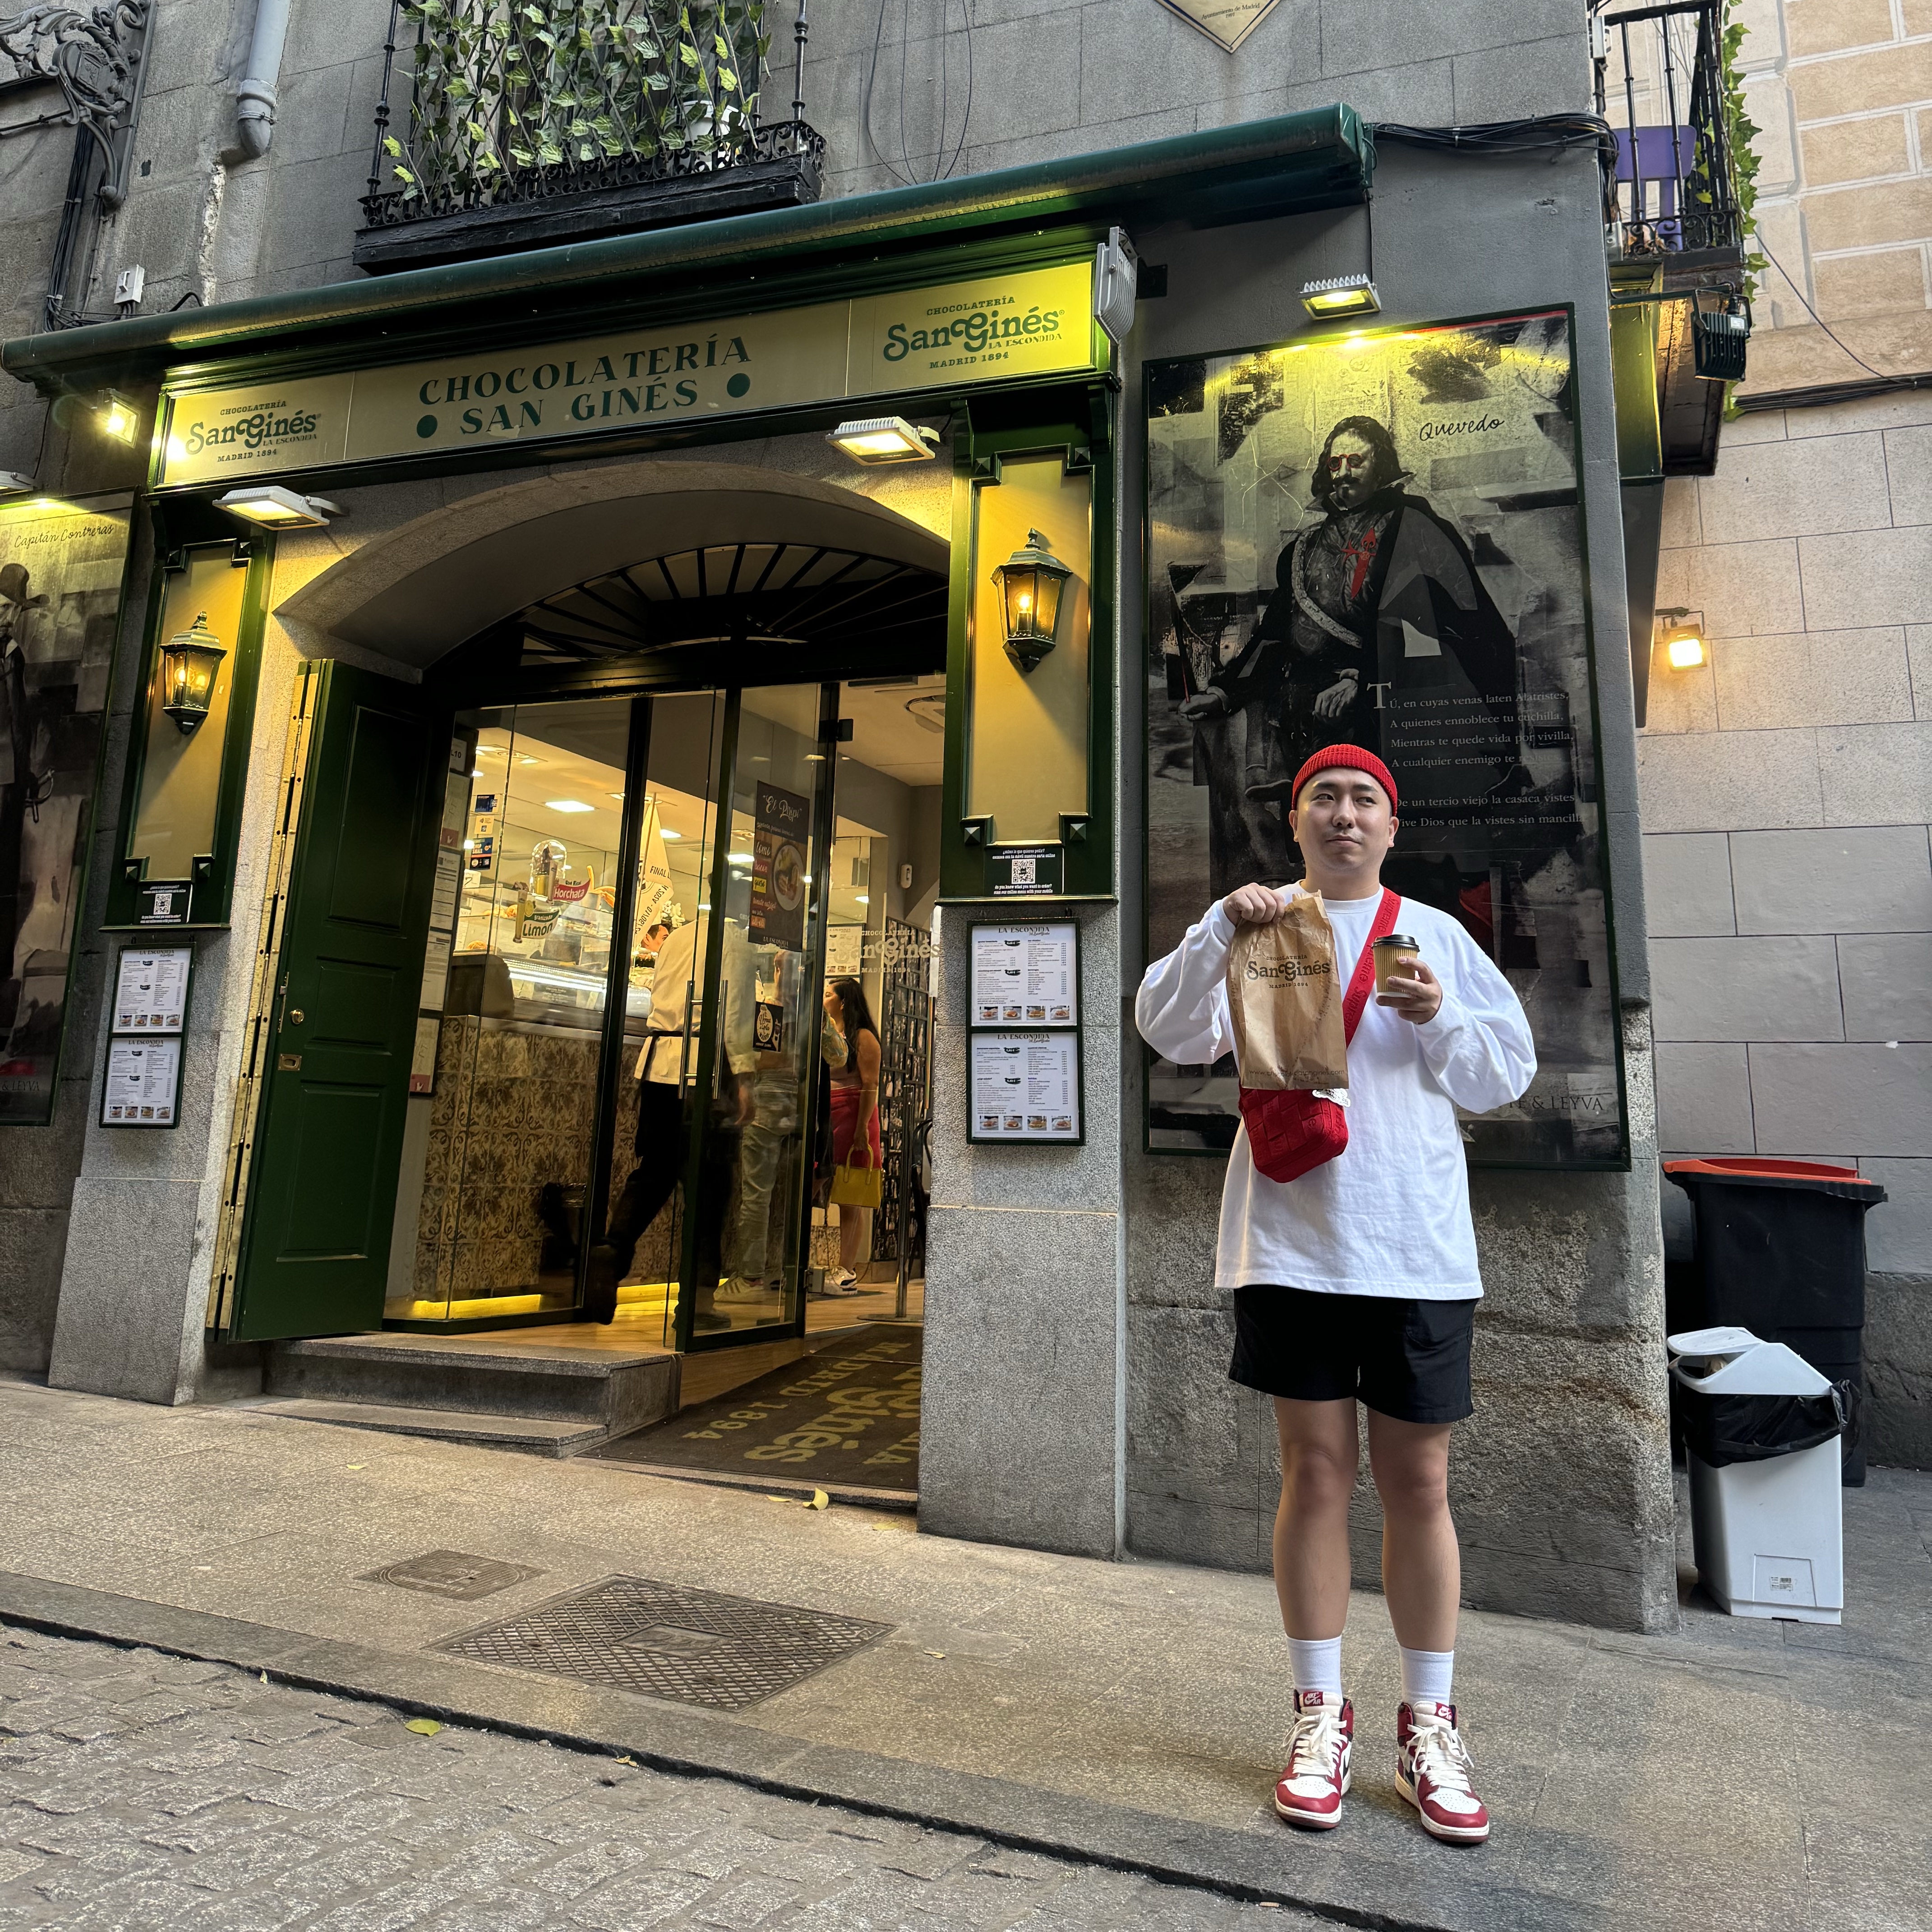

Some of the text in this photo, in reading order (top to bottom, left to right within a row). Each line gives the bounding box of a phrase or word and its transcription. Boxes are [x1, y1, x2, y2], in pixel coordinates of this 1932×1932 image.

[1201, 9, 1233, 20] Ayuntamiento
[926, 295, 1015, 317] CHOCOLATERÍA
[988, 333, 1062, 350] LA ESCONDIDA
[929, 351, 1010, 369] MADRID 1894
[419, 333, 752, 405] CHOCOLATERÍA
[220, 400, 287, 416] CHOCOLATERÍA
[460, 372, 699, 434] SAN GINÉS
[1419, 414, 1504, 442] Quevedo
[263, 433, 317, 446] LA ESCONDIDA
[217, 448, 277, 462] MADRID 1894
[14, 524, 114, 549] Capitán Contreras
[1403, 699, 1416, 708] en
[1420, 698, 1449, 708] cuyas
[1452, 697, 1482, 705] venas
[1486, 694, 1512, 703] laten
[1401, 718, 1441, 729] quienes
[1445, 714, 1499, 725] ennoblece
[1518, 712, 1563, 722] cuchilla,
[1391, 731, 1573, 748] Mientras te quede vida por vivilla,
[1391, 759, 1399, 767] A
[1403, 756, 1451, 768] cualquier
[1455, 754, 1501, 766] enemigo
[1429, 796, 1458, 806] tercio
[1462, 796, 1488, 807] viejo
[1492, 795, 1501, 804] la
[1505, 794, 1540, 803] casaca
[1544, 793, 1575, 802] vistes
[1420, 817, 1444, 827] Dios
[1448, 819, 1468, 828] que
[1472, 816, 1481, 825] la
[1485, 816, 1515, 824] vistes
[1519, 814, 1535, 823] sin
[650, 865, 666, 877] FINAL
[554, 888, 585, 899] Horchata
[1378, 895, 1398, 932] Supreme
[523, 922, 553, 936] Limón
[12, 1081, 40, 1091] LEYVA
[1532, 1095, 1545, 1109] &
[1551, 1096, 1605, 1111] LEYVA
[682, 1401, 788, 1439] 1894
